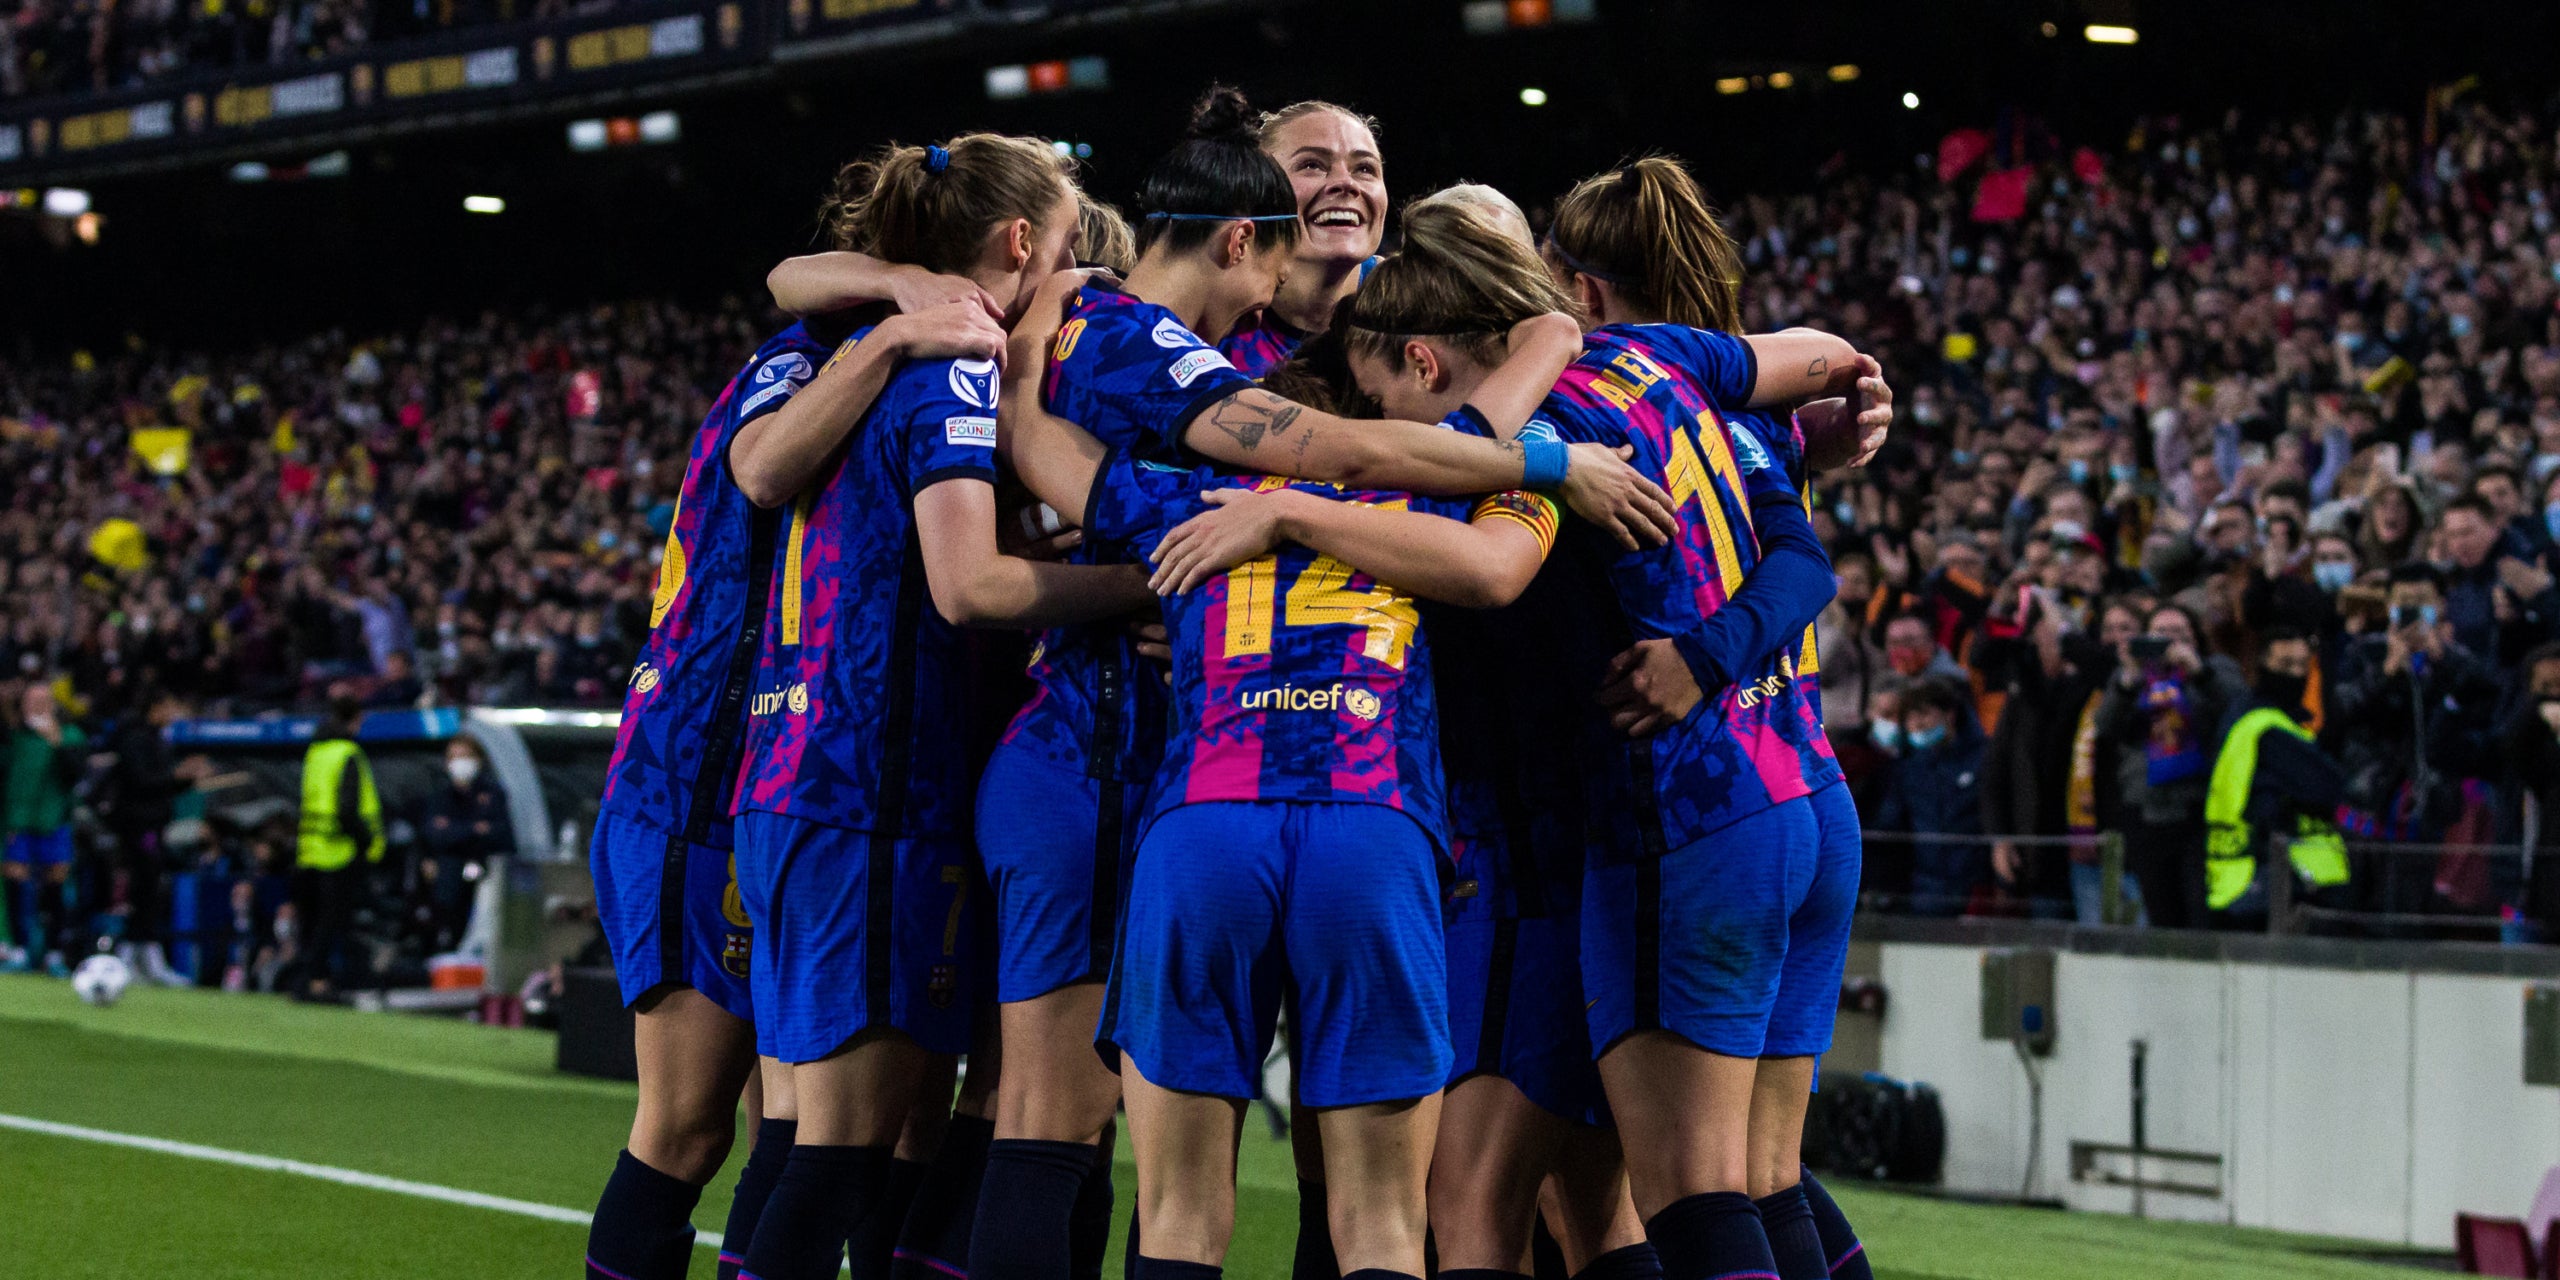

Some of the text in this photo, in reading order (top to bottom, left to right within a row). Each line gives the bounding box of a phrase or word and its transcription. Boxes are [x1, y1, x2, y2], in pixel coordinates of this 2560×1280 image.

[1665, 409, 1761, 601] 11
[1223, 499, 1420, 671] 14
[1241, 683, 1343, 712] unicef
[940, 865, 970, 956] 7
